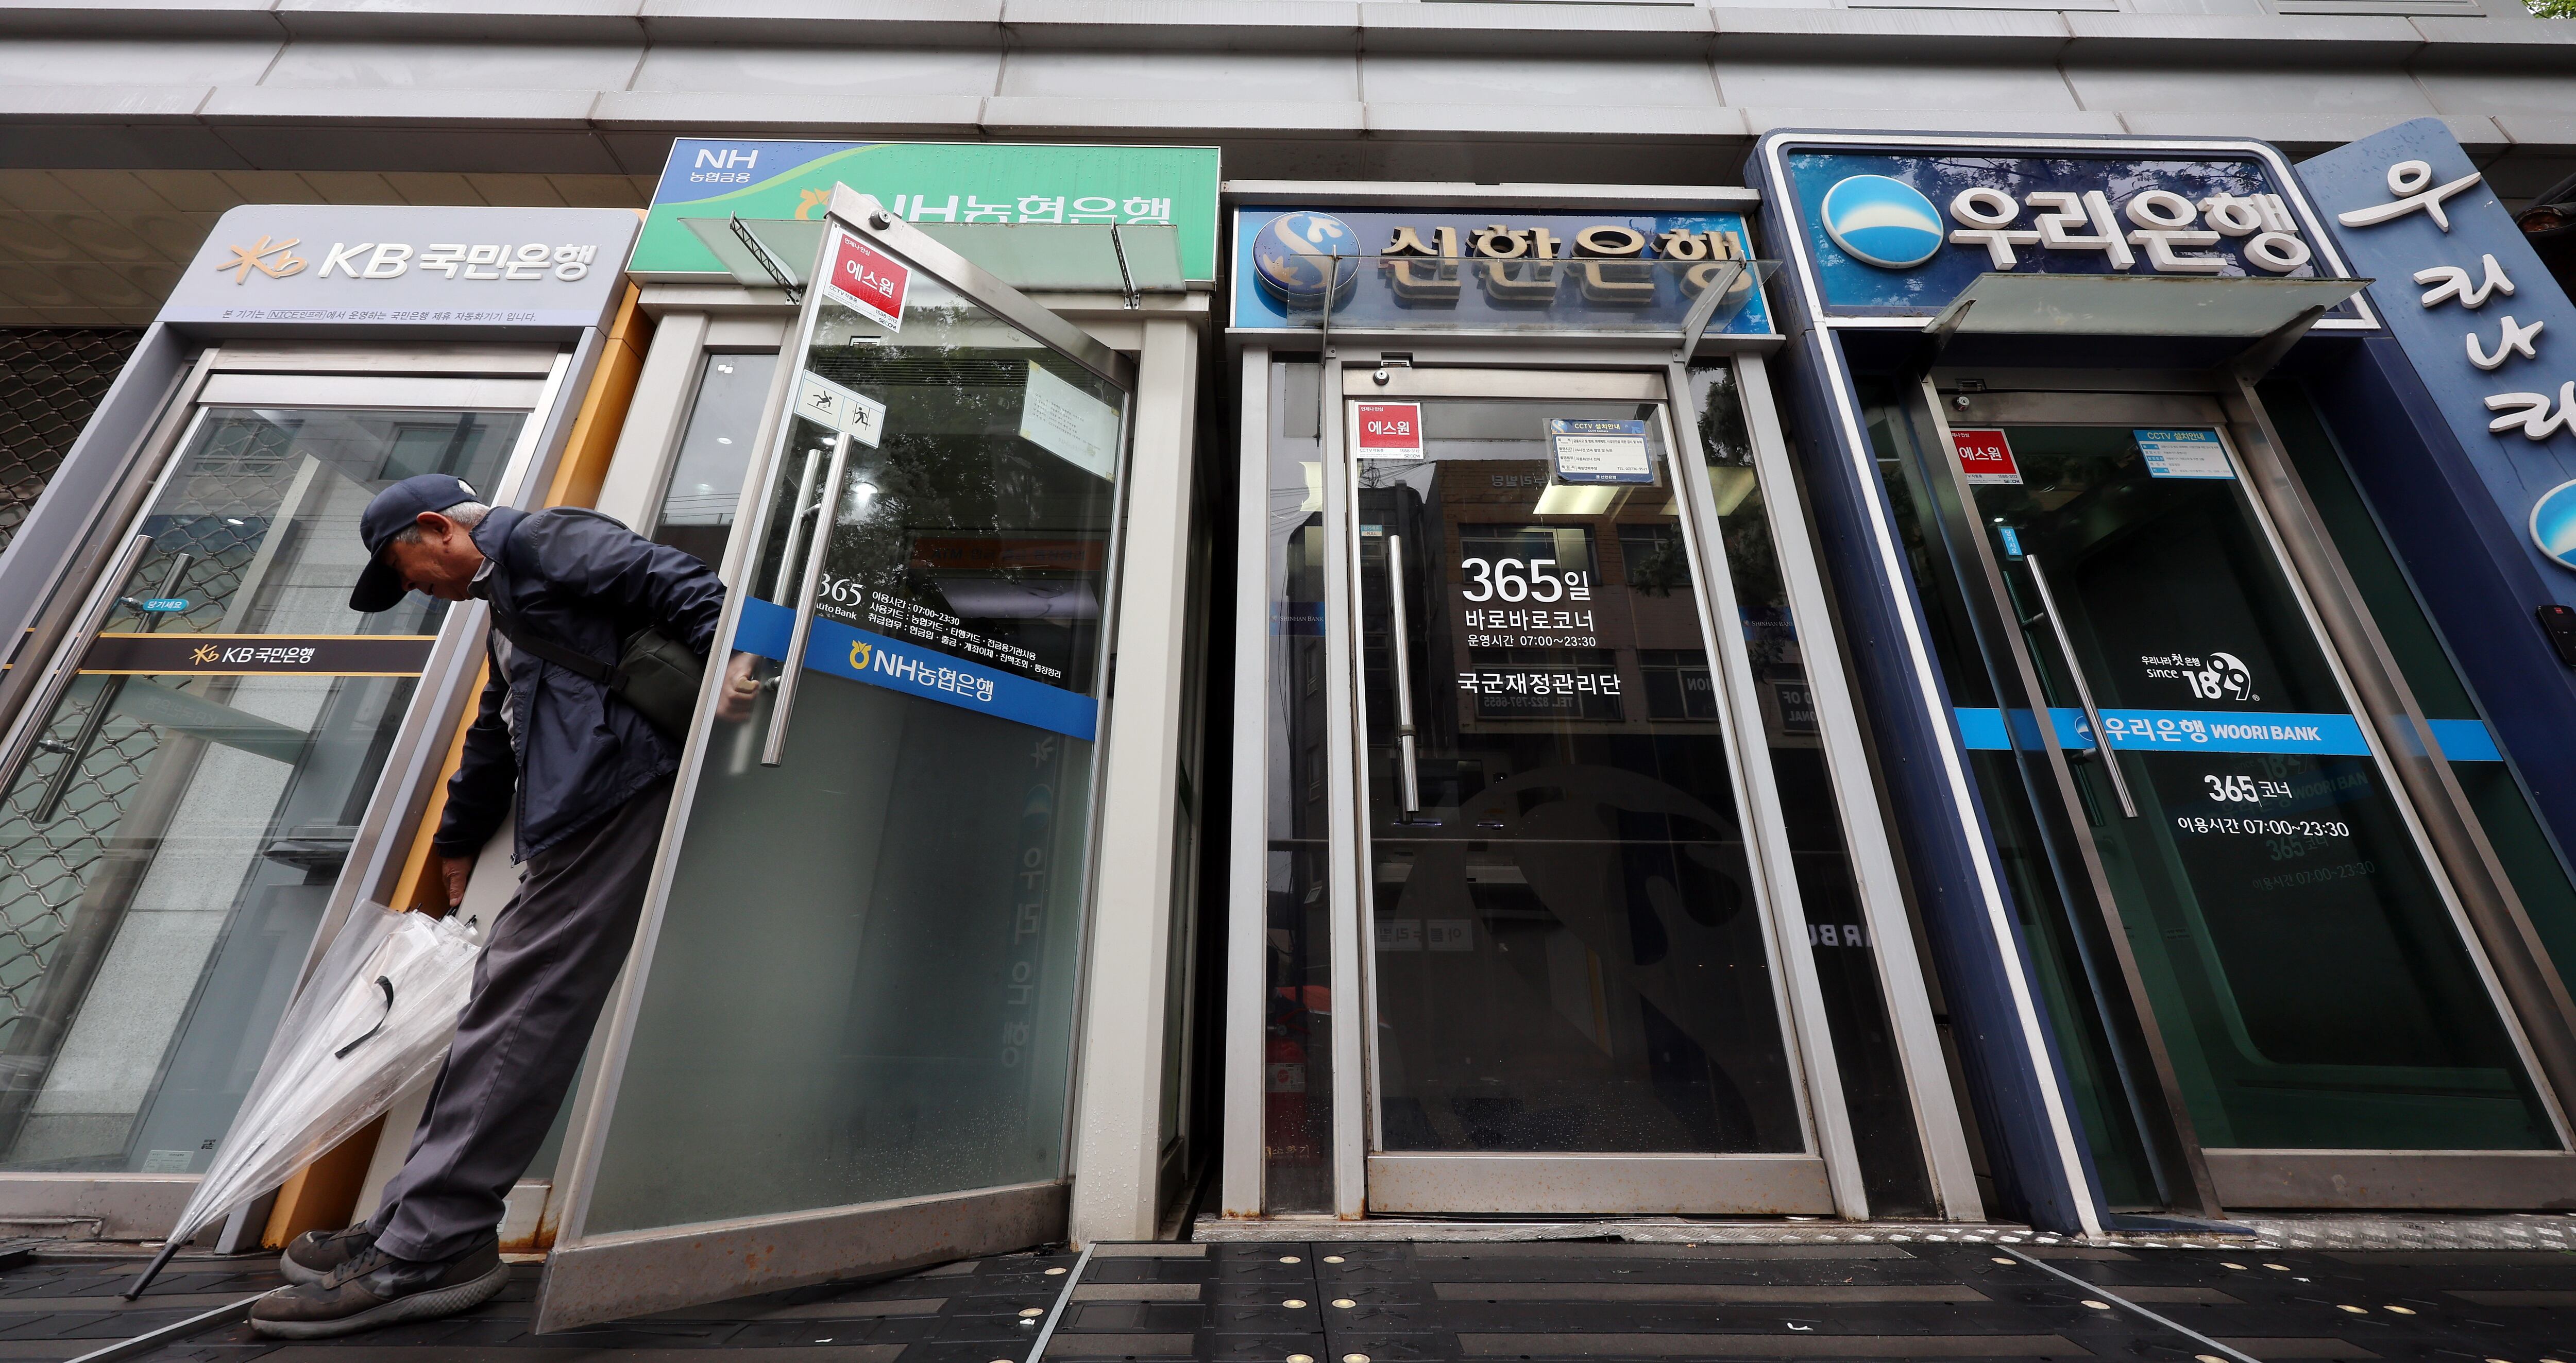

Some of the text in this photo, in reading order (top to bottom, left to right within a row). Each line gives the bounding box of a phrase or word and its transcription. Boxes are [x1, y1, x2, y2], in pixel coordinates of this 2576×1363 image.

[694, 149, 758, 169] NH
[690, 172, 750, 183] 농협금융
[1948, 186, 2311, 272] 우리은행
[844, 237, 870, 257] 언제나 안심
[317, 242, 413, 279] KB
[419, 243, 598, 281] 국민은행
[1381, 225, 1752, 303] 신한은행
[846, 260, 894, 299] 에스원
[829, 285, 858, 303] CCTV 작동중
[223, 310, 232, 318] 본
[236, 310, 265, 319] 기기는
[348, 311, 386, 320] 운영하는
[391, 311, 429, 320] 국민은행
[432, 312, 451, 321] 제휴
[454, 312, 503, 321] 자동화기기
[506, 313, 536, 321] 입니다.
[876, 309, 898, 324] 1588-3112
[878, 317, 896, 330] SECOM
[1368, 421, 1410, 435] 에스원
[2174, 432, 2206, 440] 설치안내
[1959, 447, 2003, 461] 에스원
[818, 573, 864, 606] 365
[1461, 558, 1591, 603] 365일
[147, 601, 182, 609] 당기세요
[835, 607, 857, 620] Bank
[872, 591, 960, 625] 이용시간 07:00~23:30
[1465, 608, 1594, 632] 바로바로코너
[869, 602, 1036, 661] 사용카드 농협카드 타행카드 전금융기관사용
[1467, 634, 1596, 648] 운영시간 07:00~23:30
[222, 647, 255, 663] KB
[255, 647, 315, 664] 국민은행
[868, 612, 1061, 679] 취급업무 현금입 출금 계좌이체 잔액조회 통장정리
[2141, 653, 2201, 667] 우리나라 첫 은행
[1458, 673, 1621, 695] 국군재정관리단
[2105, 718, 2322, 743] 우리은행 WOORI BANK
[2178, 816, 2350, 838] 이용시간 07:00~23:30
